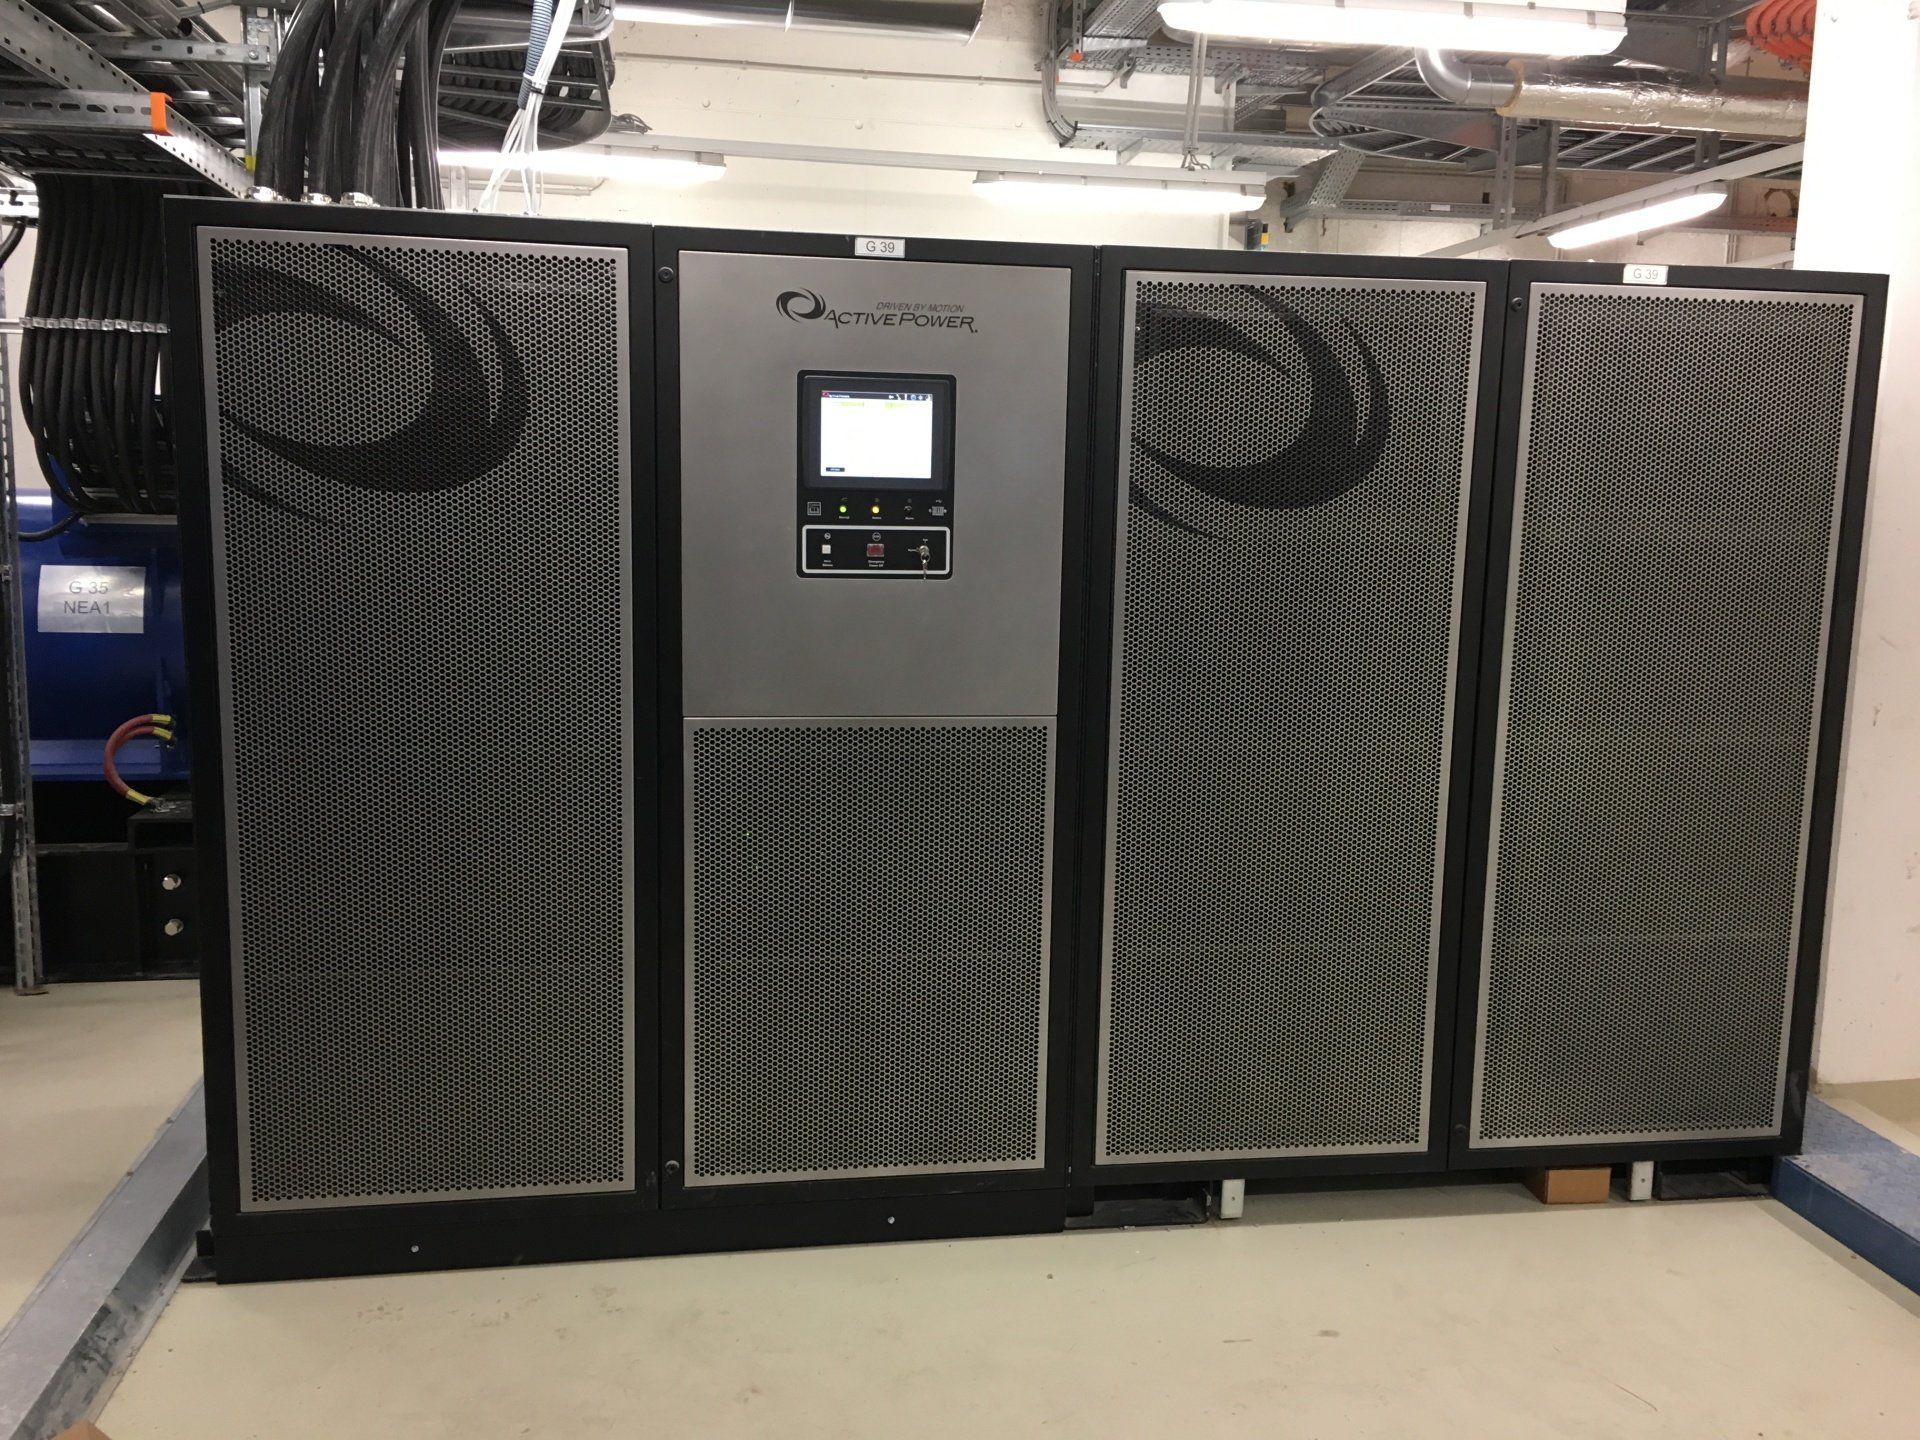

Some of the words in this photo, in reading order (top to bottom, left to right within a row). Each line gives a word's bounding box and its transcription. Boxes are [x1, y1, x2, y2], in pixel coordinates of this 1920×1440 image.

[866, 240, 876, 252] G
[880, 241, 895, 253] 39
[1633, 268, 1642, 279] G
[1645, 269, 1658, 280] 39
[876, 301, 911, 311] DRIVEN
[912, 303, 926, 312] BY
[927, 304, 965, 313] MOTION
[69, 581, 82, 594] G
[88, 581, 109, 595] 35
[64, 600, 111, 614] NEA1
